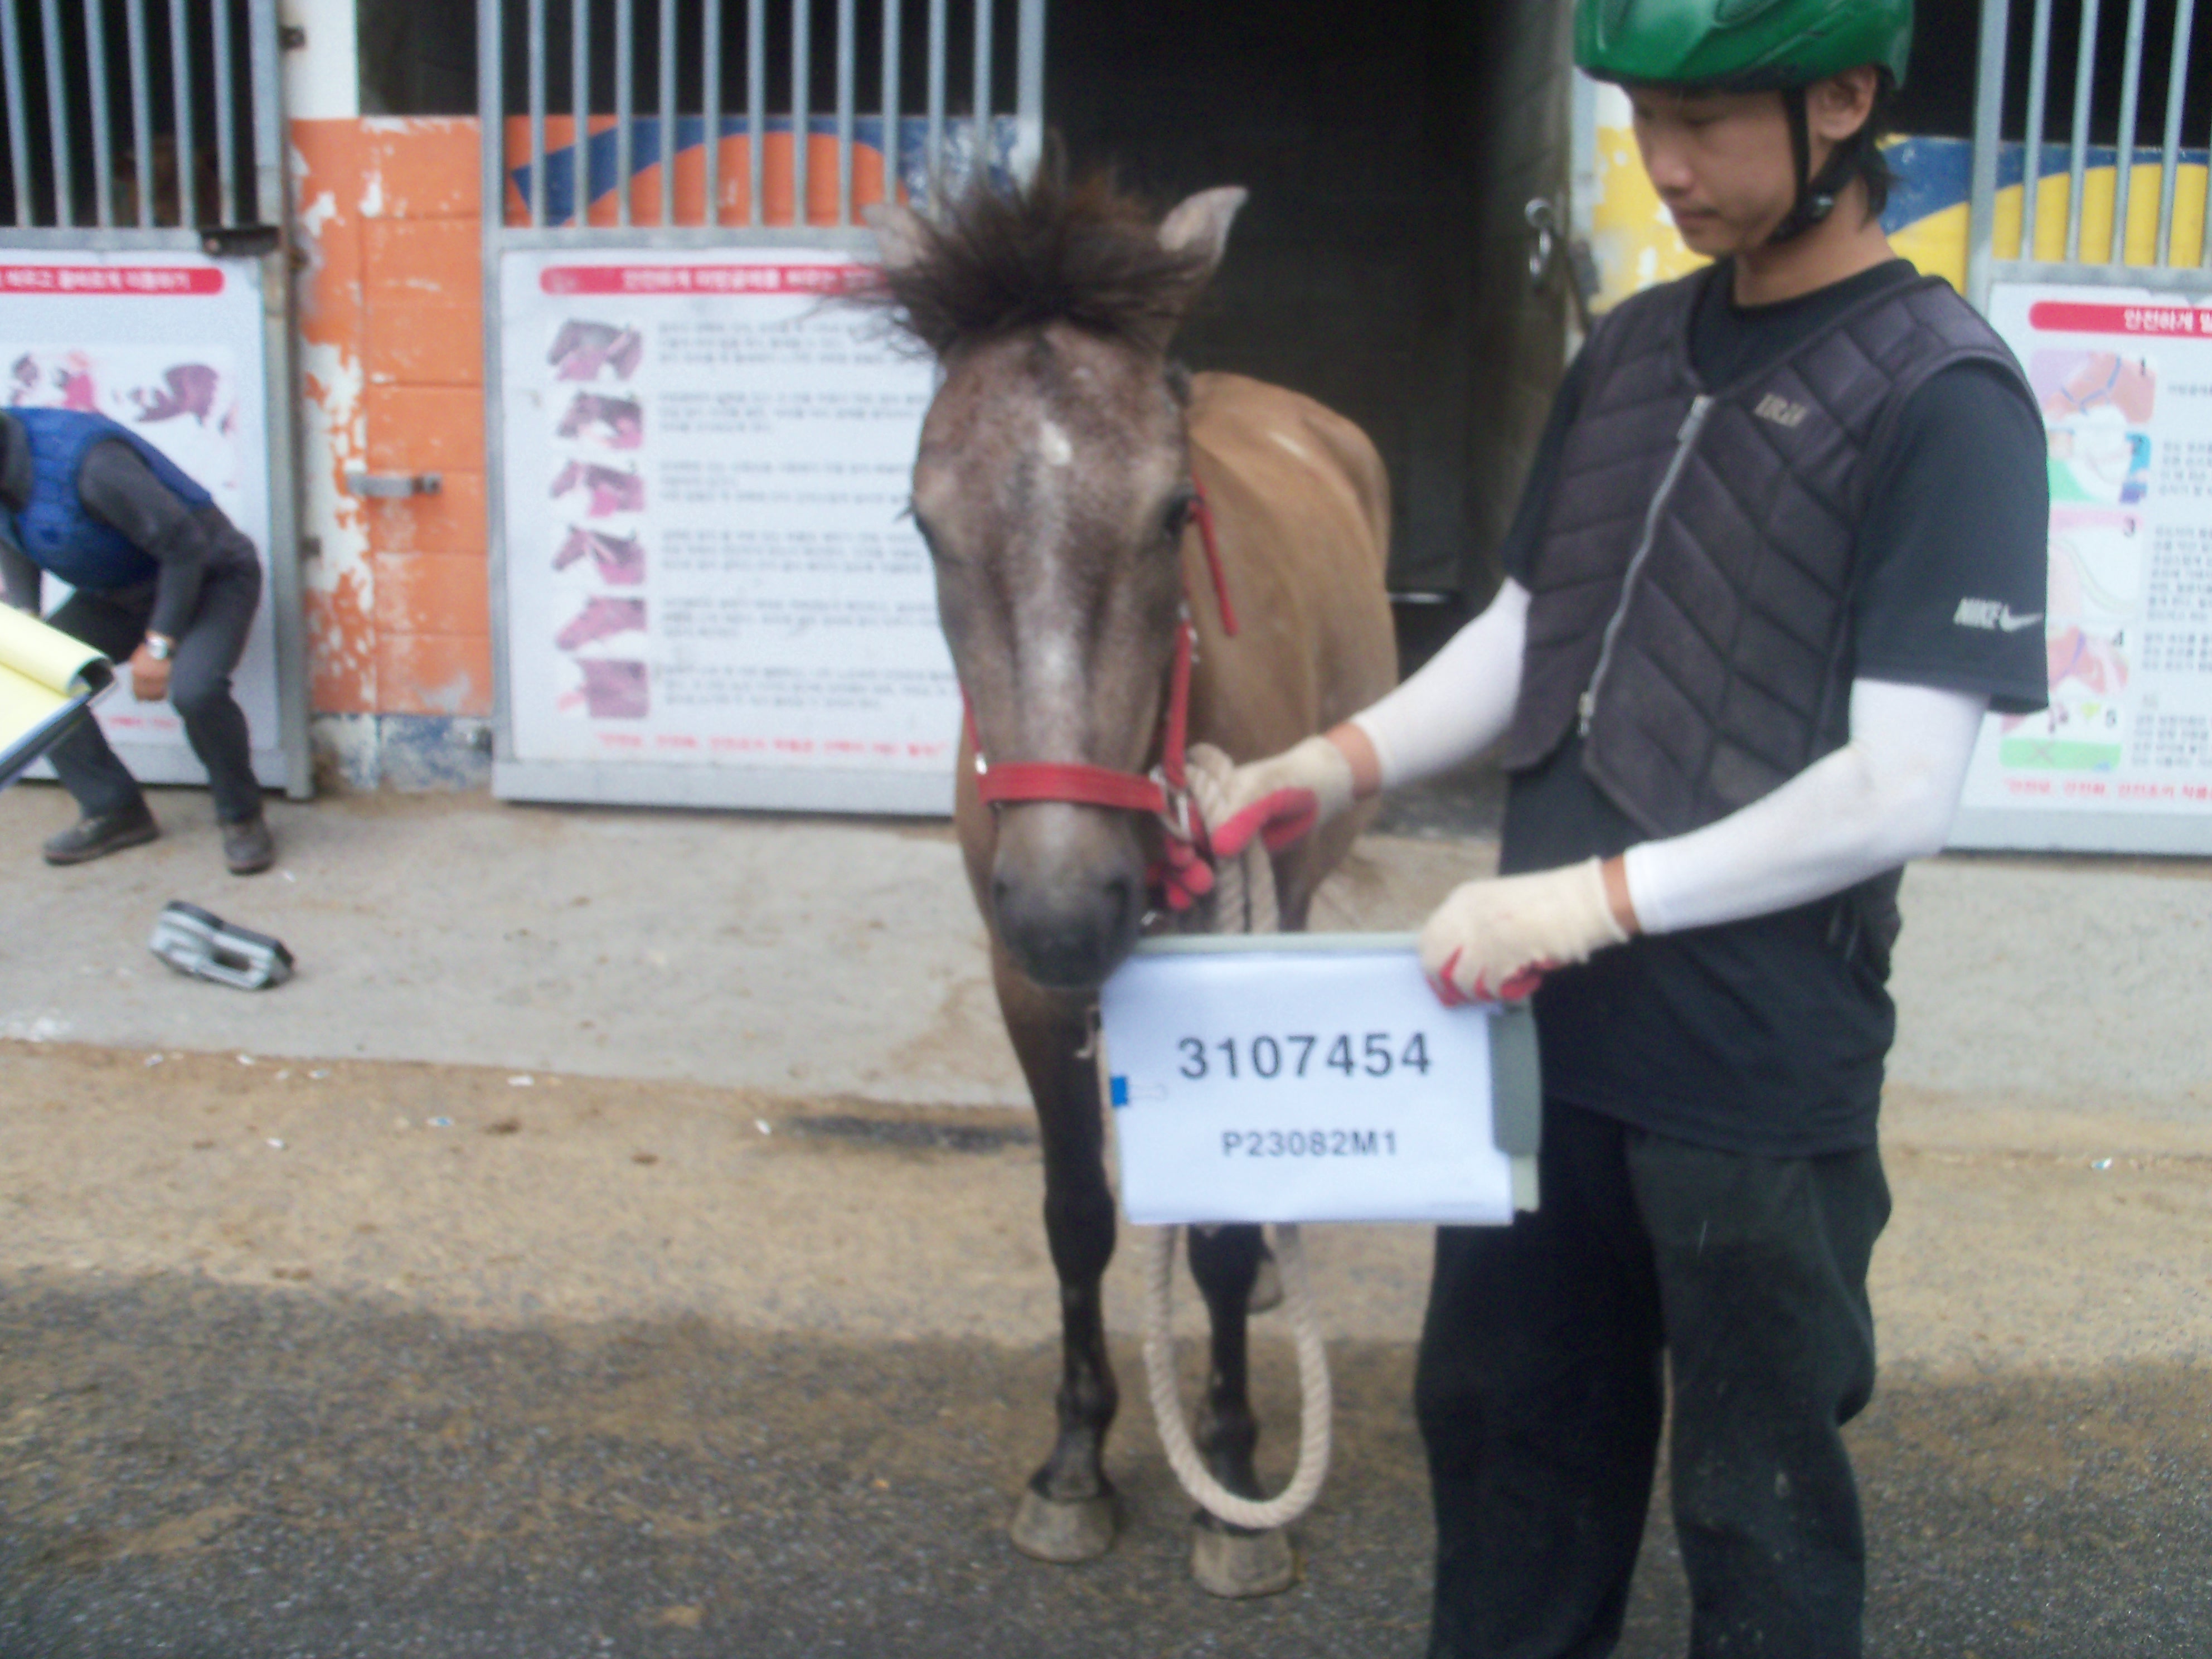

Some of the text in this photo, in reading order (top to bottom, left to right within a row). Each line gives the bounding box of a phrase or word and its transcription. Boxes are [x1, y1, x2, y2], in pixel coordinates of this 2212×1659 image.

[2124, 309, 2193, 333] 안전하게
[1952, 596, 2003, 630] NIKE
[1177, 1031, 1432, 1080] 3107454
[1222, 1130, 1398, 1157] P23082M1
